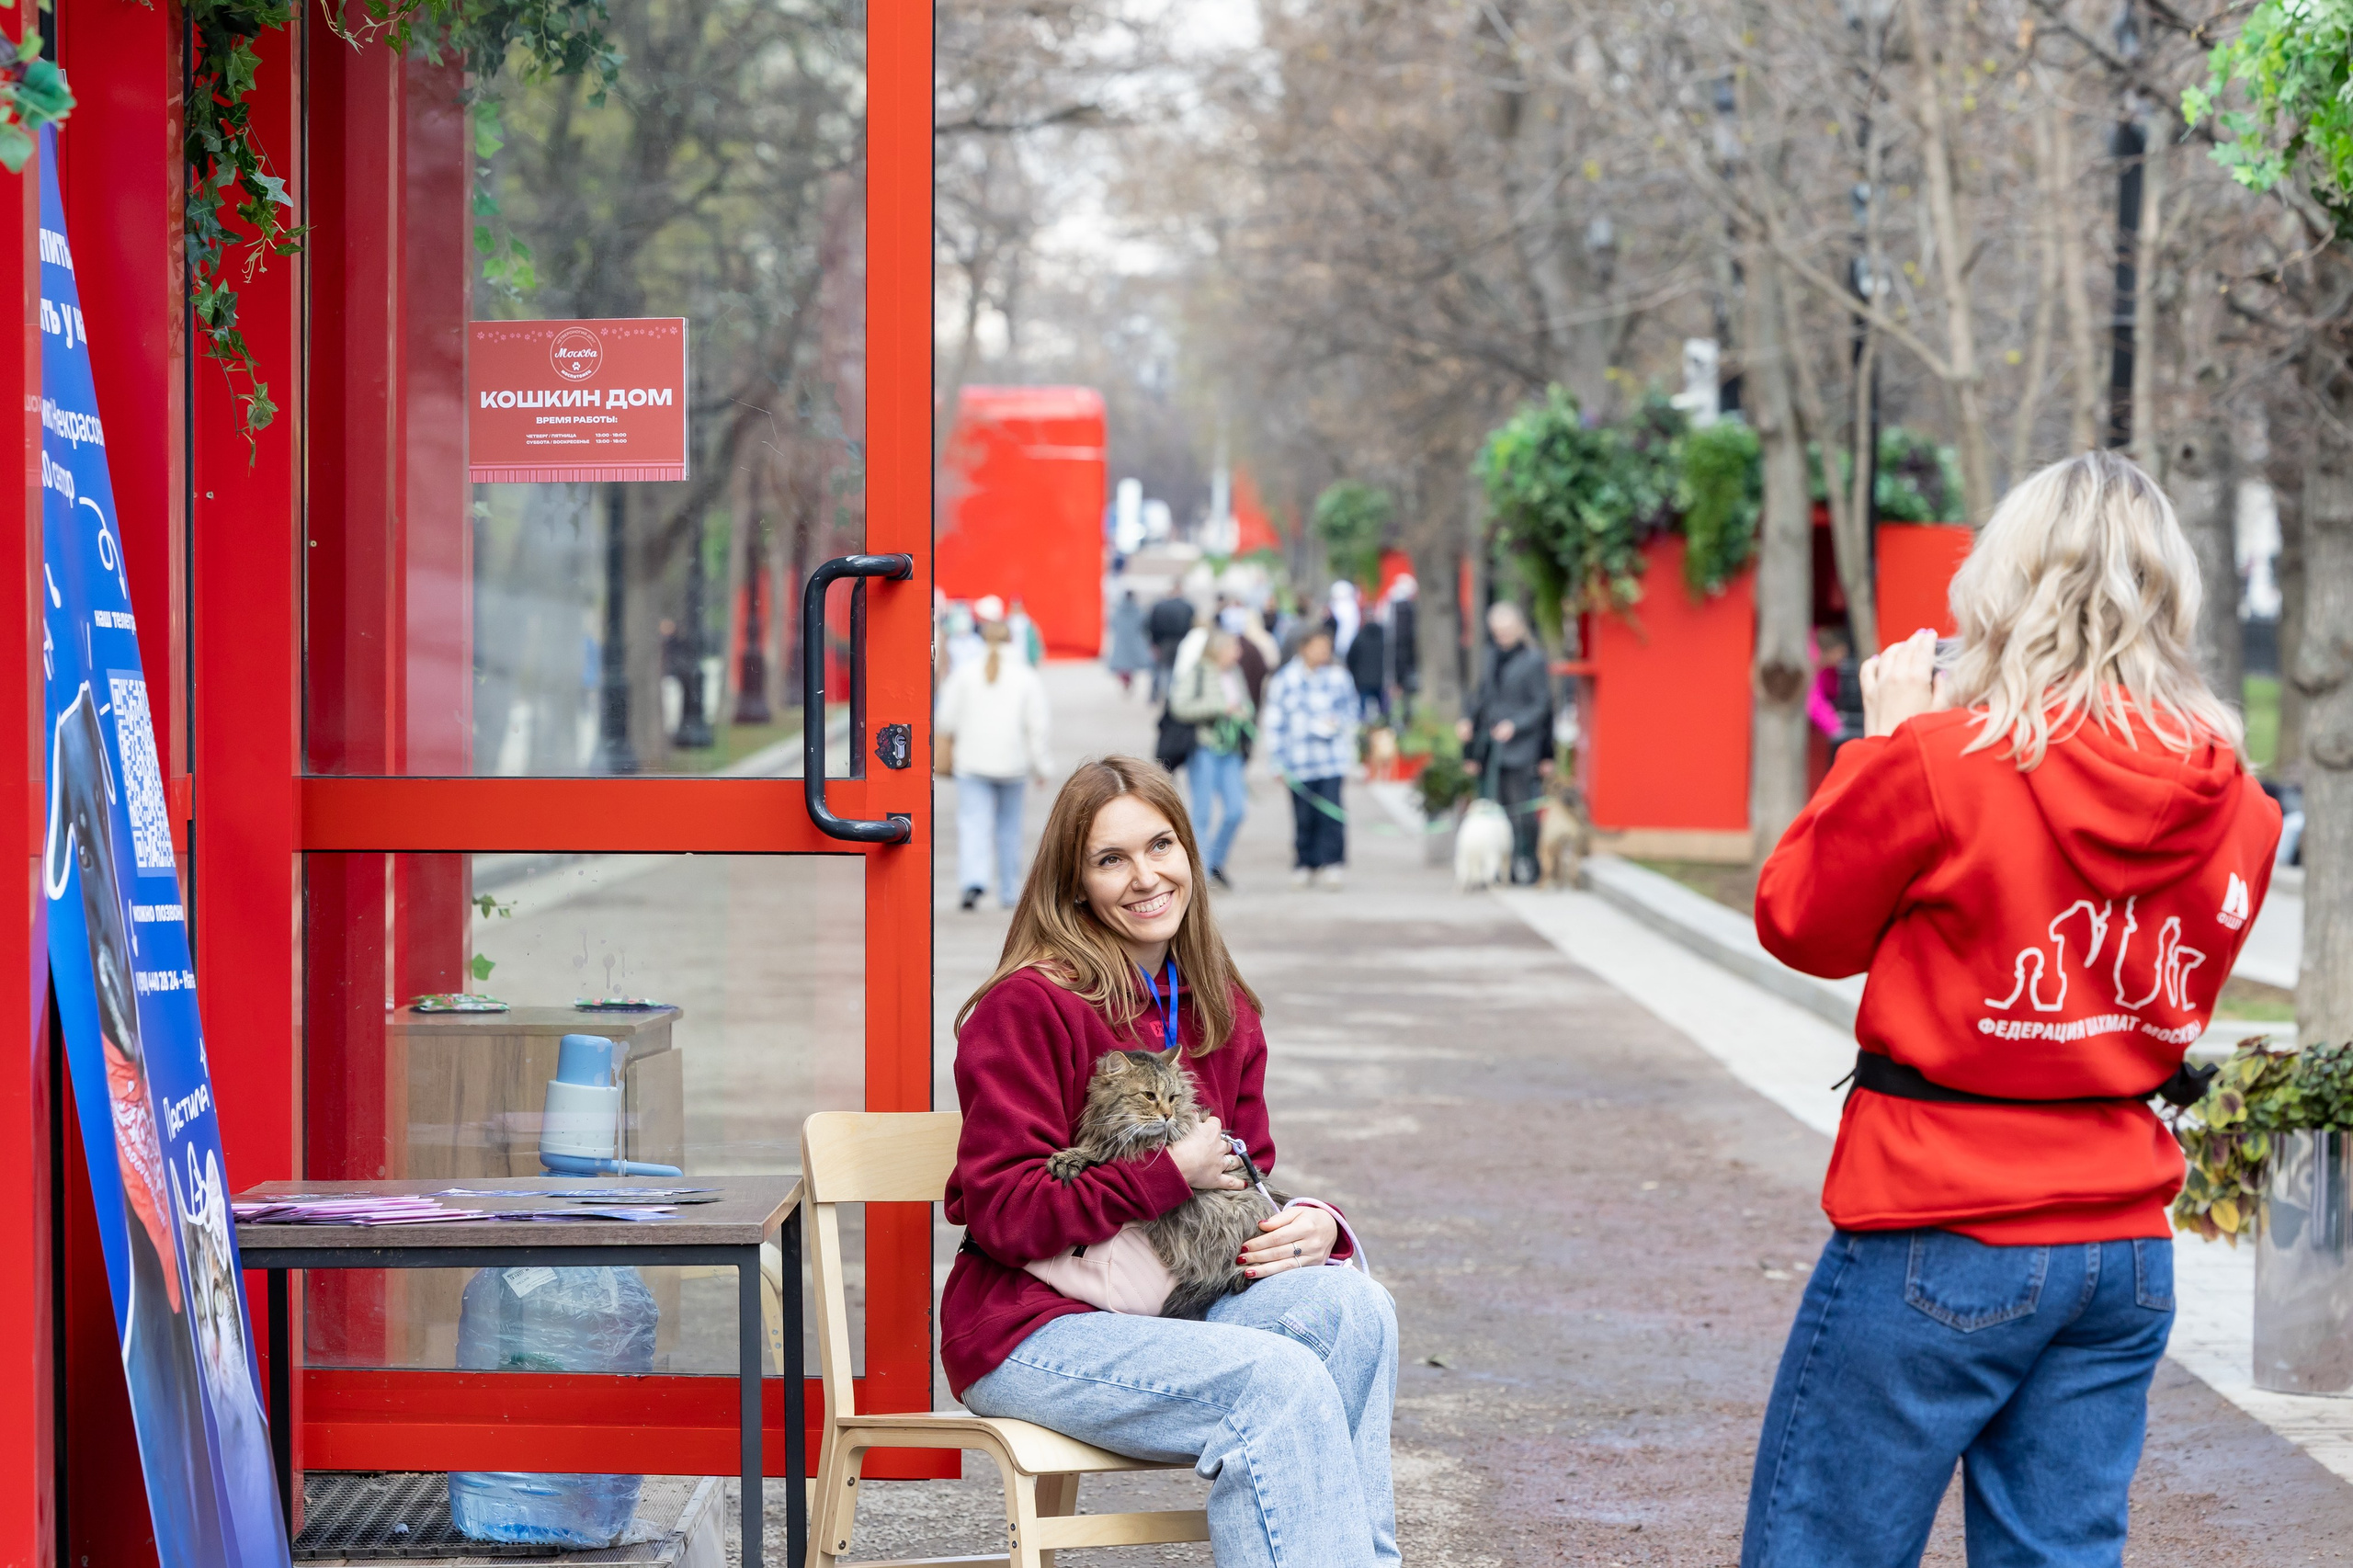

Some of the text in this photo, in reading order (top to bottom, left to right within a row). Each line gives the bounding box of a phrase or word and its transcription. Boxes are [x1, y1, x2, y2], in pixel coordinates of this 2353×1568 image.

[60, 303, 73, 349] у
[554, 347, 598, 358] Москва
[480, 388, 672, 410] КОШКИН ДОМ
[573, 415, 618, 424] РАБОТЫ:
[94, 610, 112, 629] наш
[159, 971, 169, 991] 28
[168, 970, 179, 990] 24
[1978, 1017, 2086, 1043] ФЕДЕРАЦИЯ
[2084, 1014, 2140, 1037] ШАХМАТ
